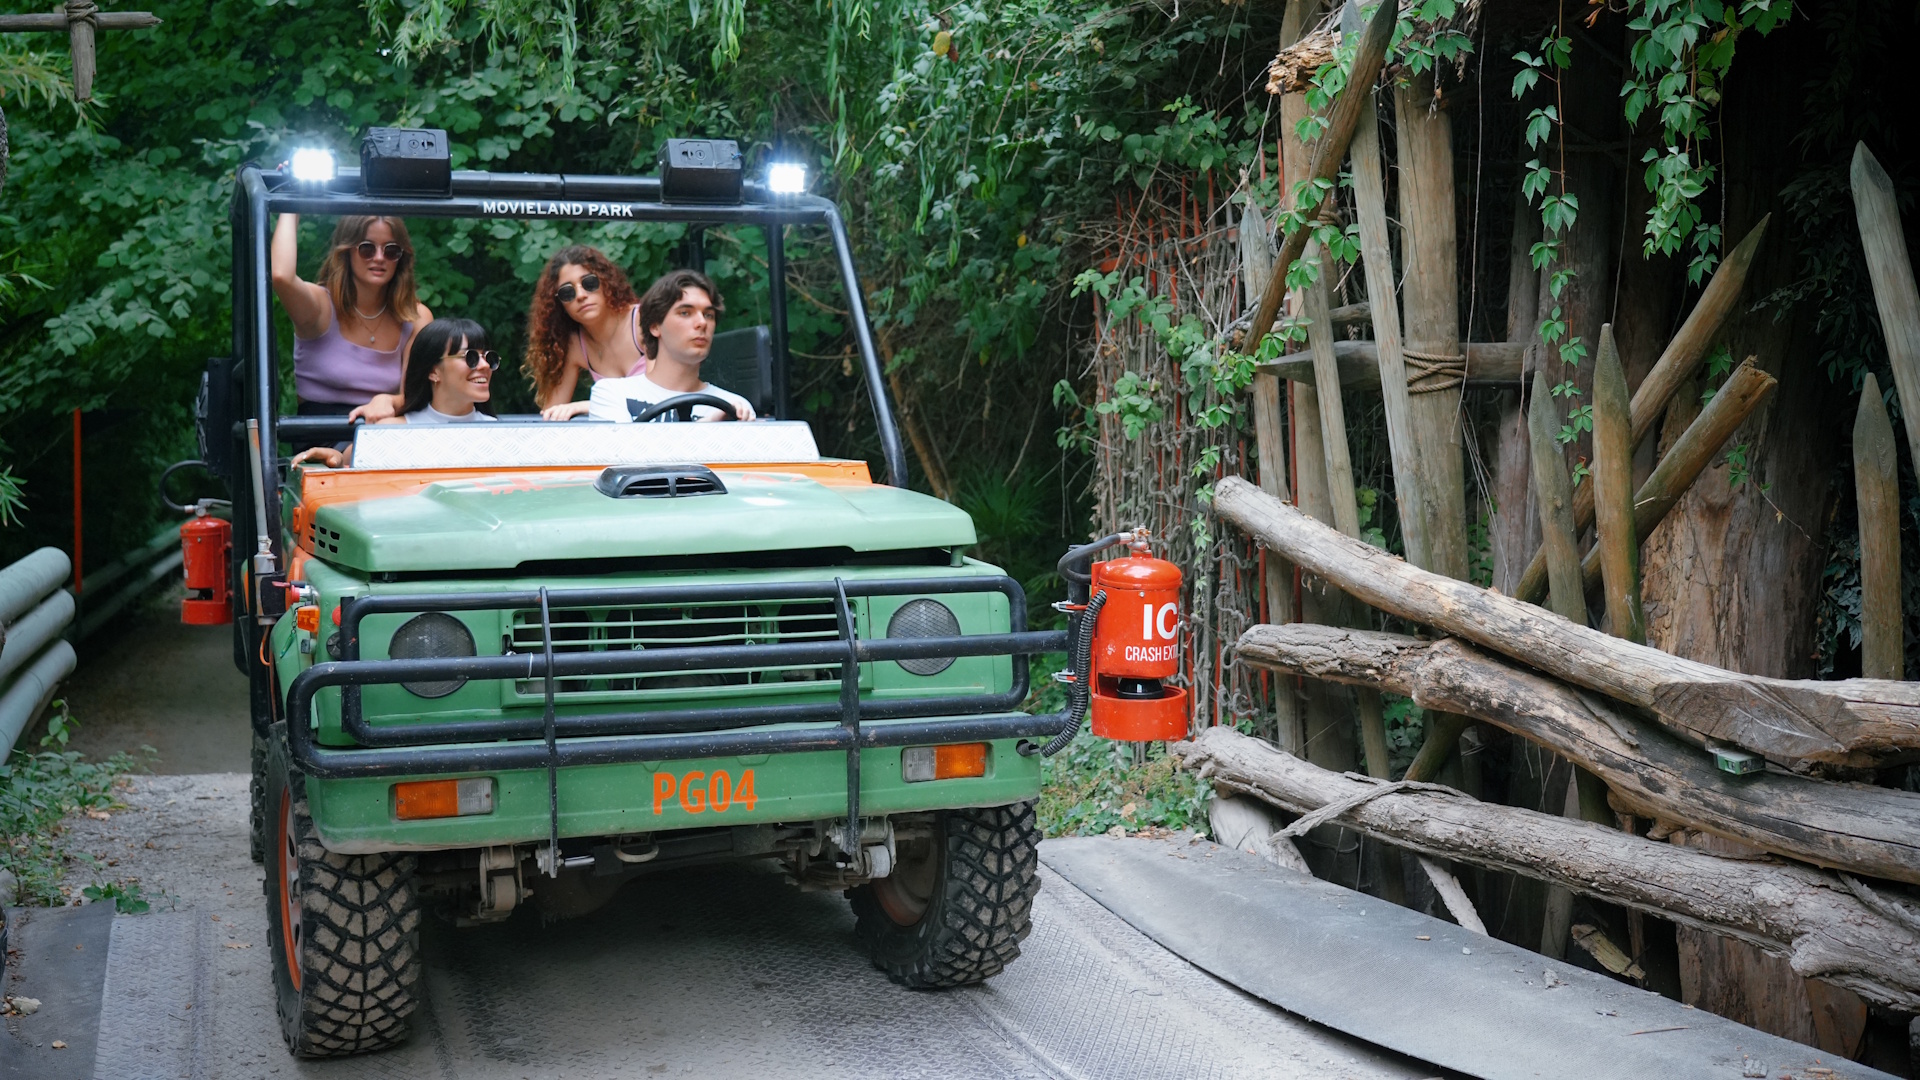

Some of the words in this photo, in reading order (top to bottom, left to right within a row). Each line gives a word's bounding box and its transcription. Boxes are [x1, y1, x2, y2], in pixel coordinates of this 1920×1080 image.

[483, 201, 583, 216] MOVIELAND
[588, 203, 633, 217] PARK
[1125, 645, 1162, 661] CRASH
[653, 769, 758, 815] PG04
